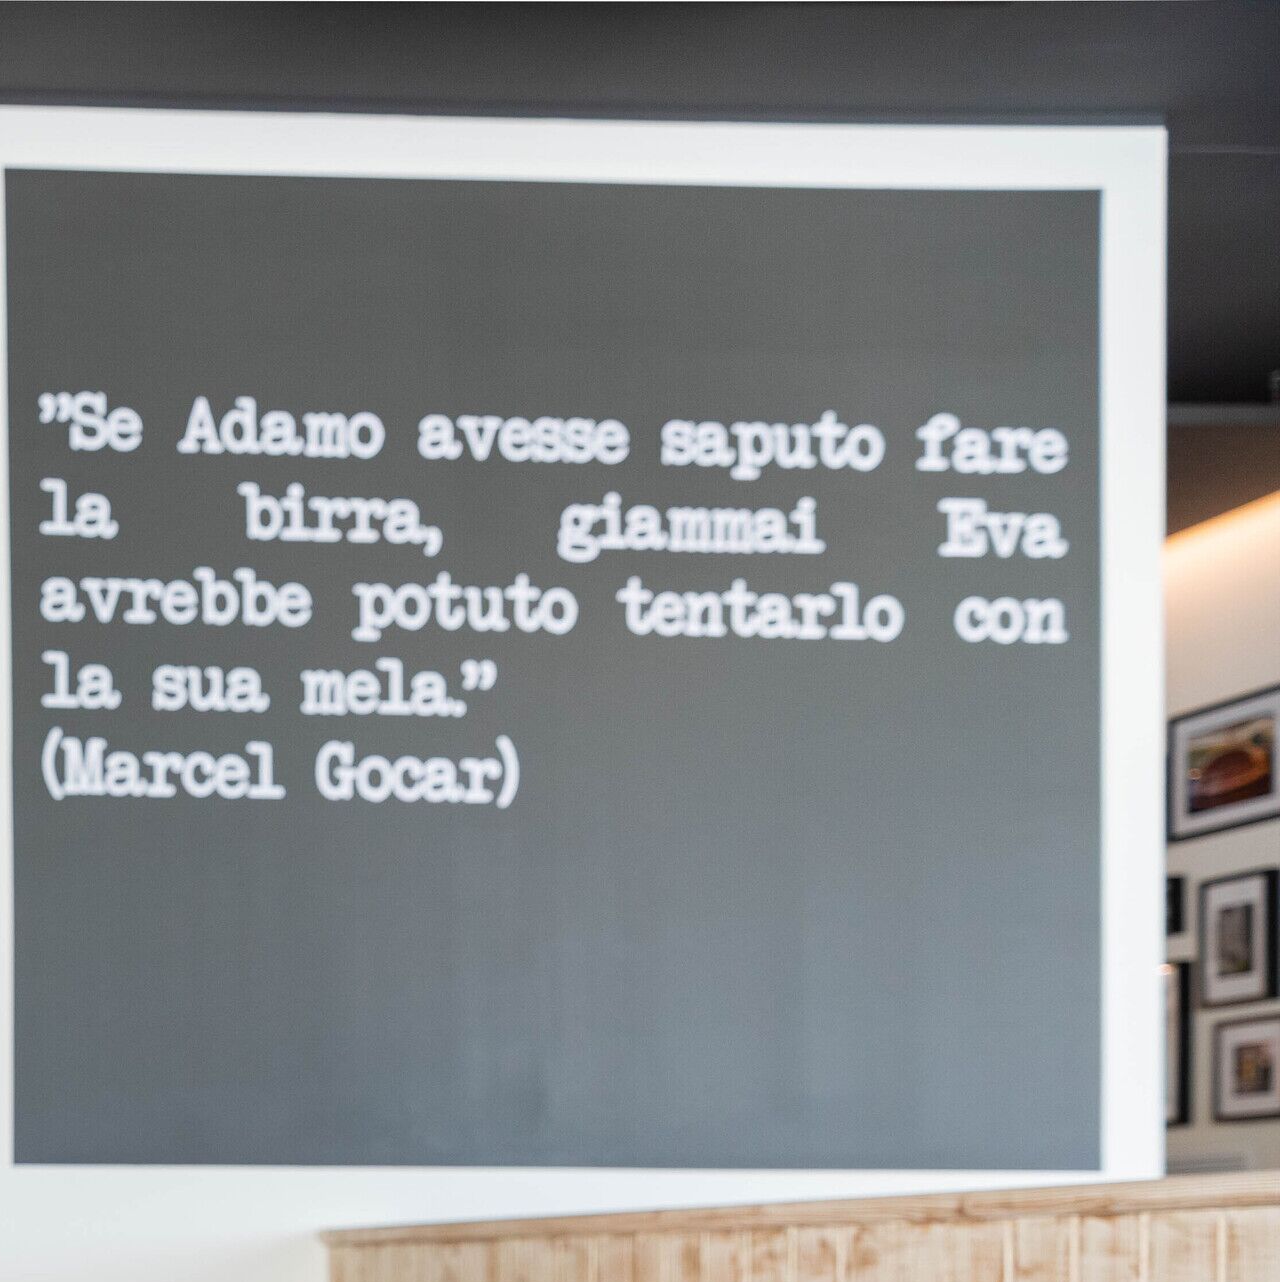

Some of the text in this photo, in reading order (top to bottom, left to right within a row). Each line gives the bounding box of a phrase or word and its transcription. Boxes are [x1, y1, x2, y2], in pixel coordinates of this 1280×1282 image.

[176, 396, 386, 460] Adamo
[417, 414, 630, 465] avesse
[660, 409, 886, 482] saputo
[915, 412, 1069, 475] fare
[39, 477, 1070, 564] la birra, giammai Eva
[40, 566, 1070, 646] avrebbe potuto tentarlo con
[41, 650, 122, 710] la
[152, 664, 271, 713] sua
[41, 726, 521, 809] (Marcel Gocar)
